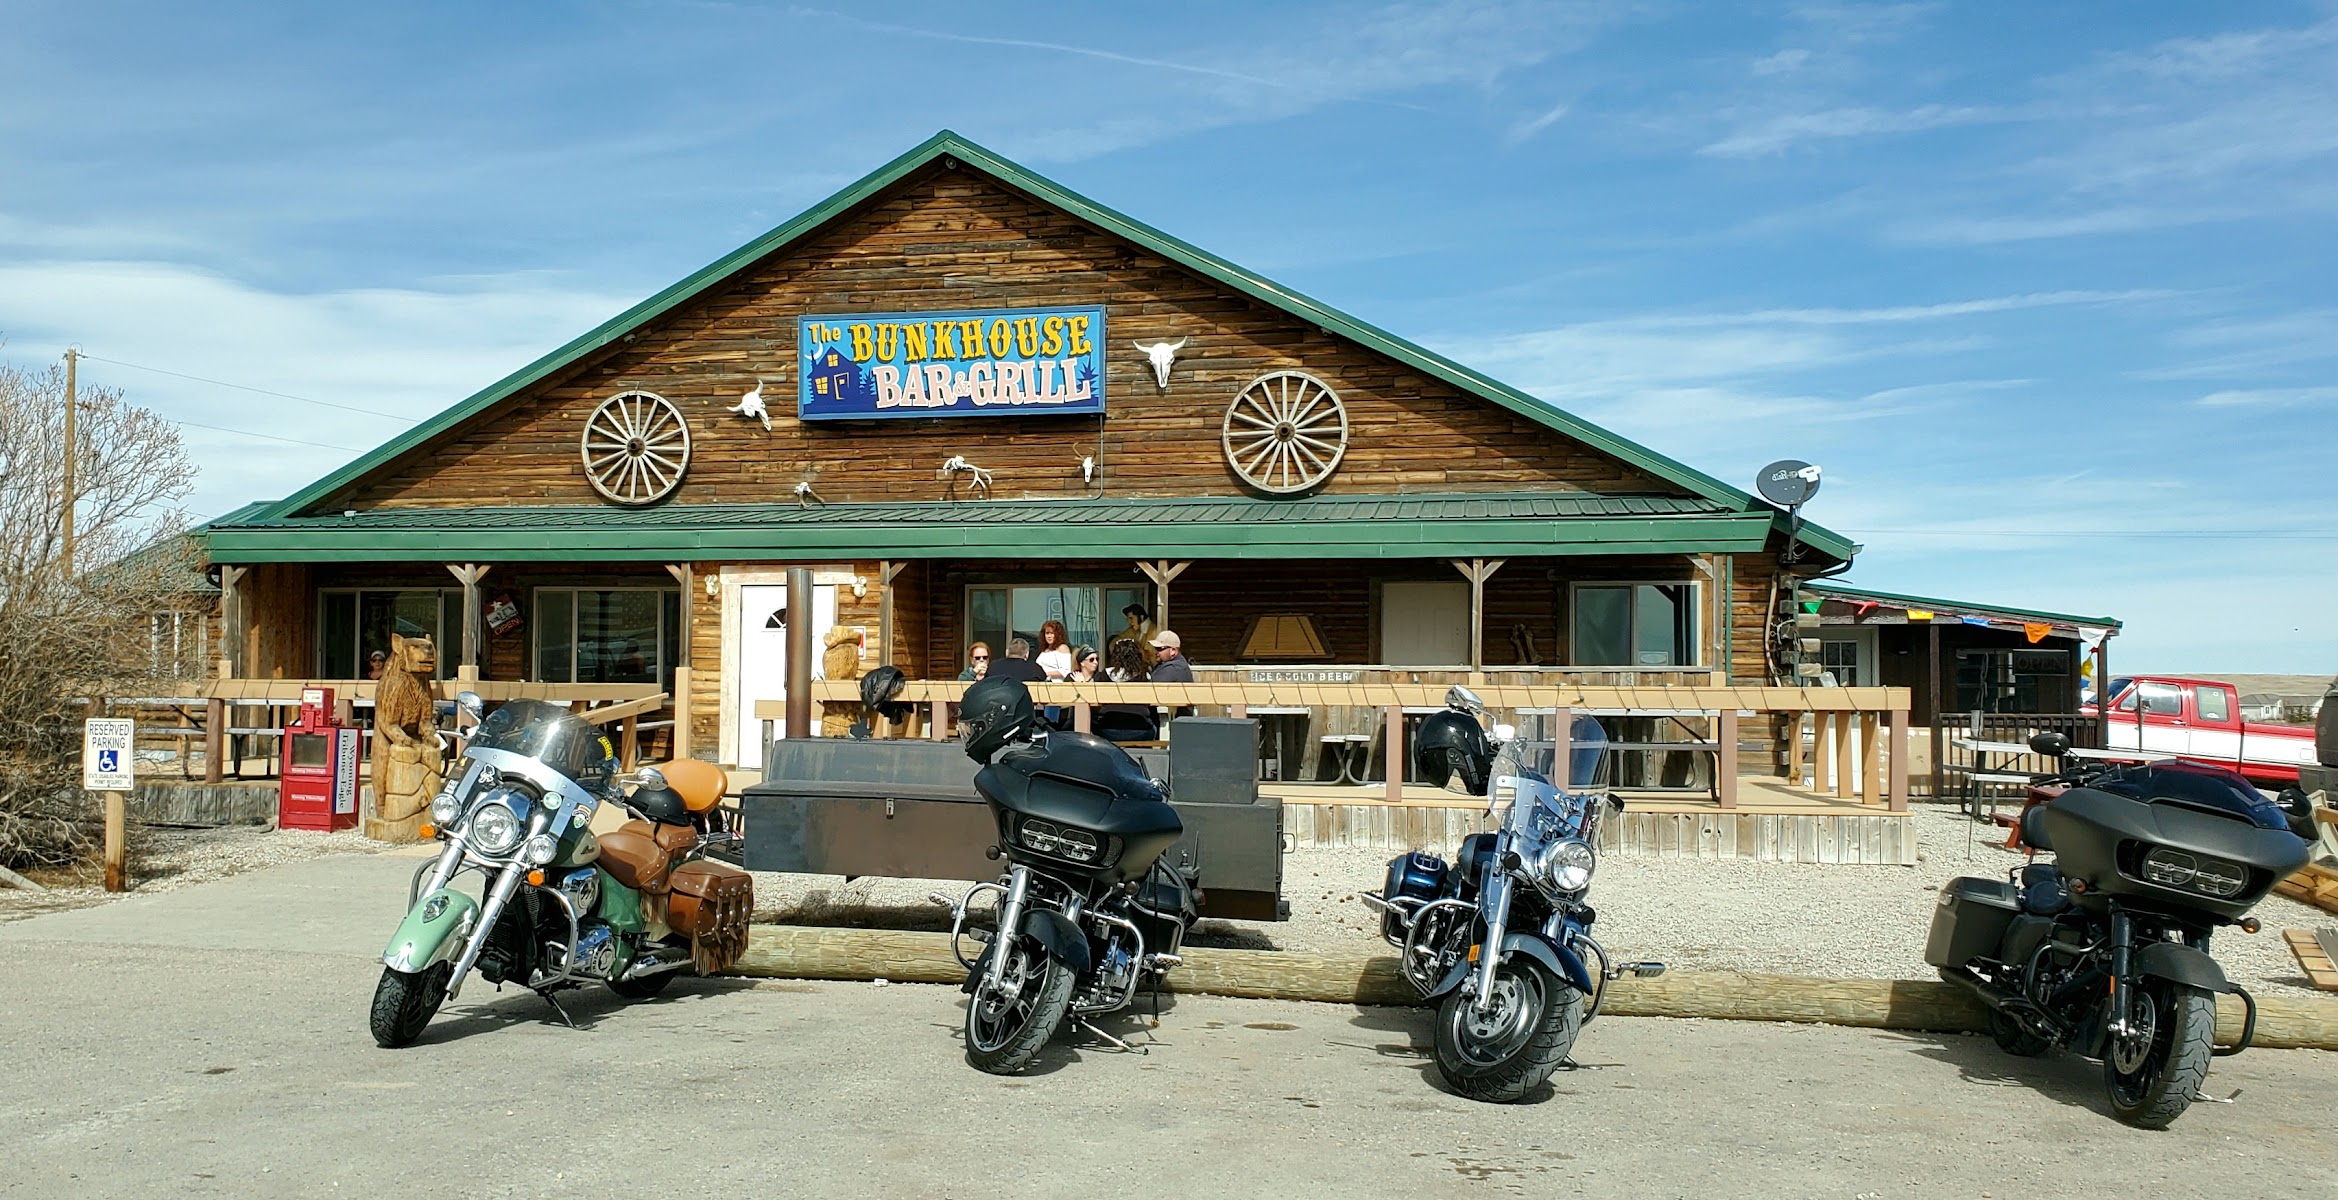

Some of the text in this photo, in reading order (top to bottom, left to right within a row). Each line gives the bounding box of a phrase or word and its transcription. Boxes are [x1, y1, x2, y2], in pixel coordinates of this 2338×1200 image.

[808, 323, 841, 344] The
[848, 315, 1092, 362] BUNKHOUSE
[495, 617, 520, 635] OPEN
[89, 723, 130, 736] RESERVED
[92, 736, 126, 749] PARKING
[346, 744, 356, 796] Wyoming
